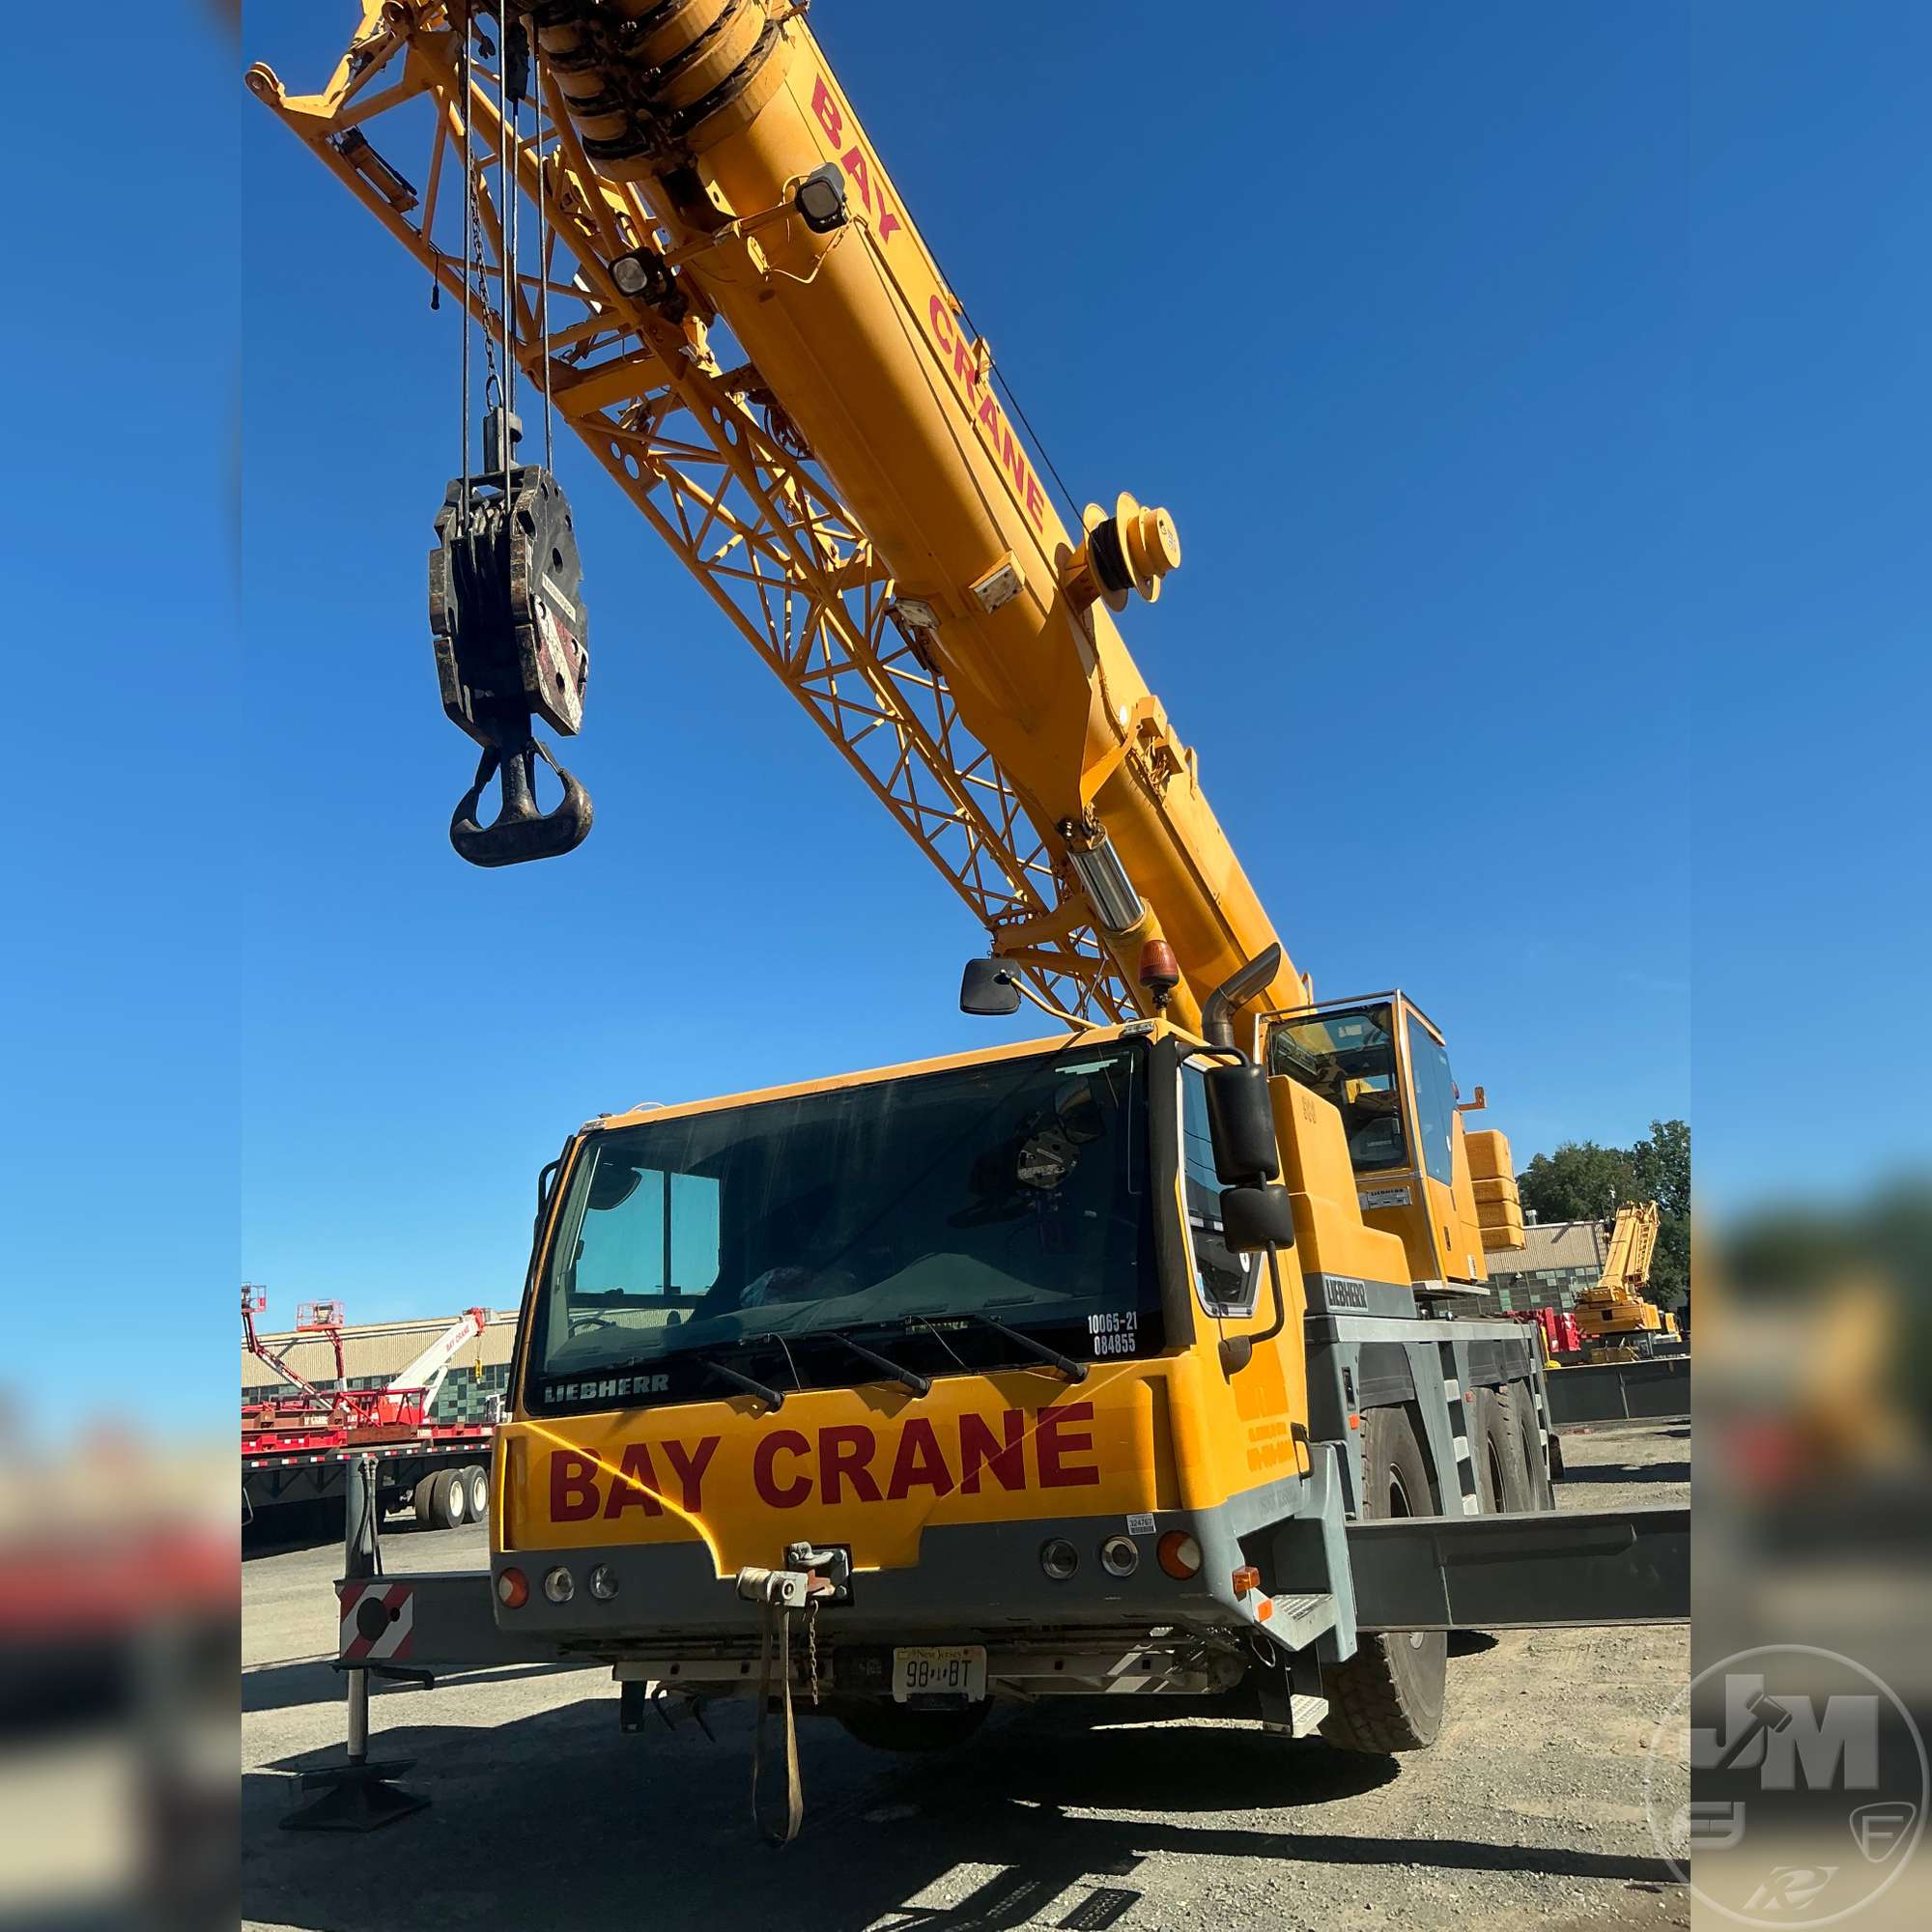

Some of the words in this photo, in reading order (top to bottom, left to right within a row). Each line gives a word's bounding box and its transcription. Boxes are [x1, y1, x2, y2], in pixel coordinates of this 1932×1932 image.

[811, 73, 901, 243] BAY
[929, 295, 1044, 534] CRANE
[1326, 1279, 1368, 1308] LIEBHERR
[1088, 1311, 1137, 1334] 10065-21
[1094, 1333, 1136, 1355] 084855
[544, 1374, 669, 1403] LIEBHERR
[551, 1435, 722, 1522] BAY
[753, 1402, 1102, 1509] CRANE
